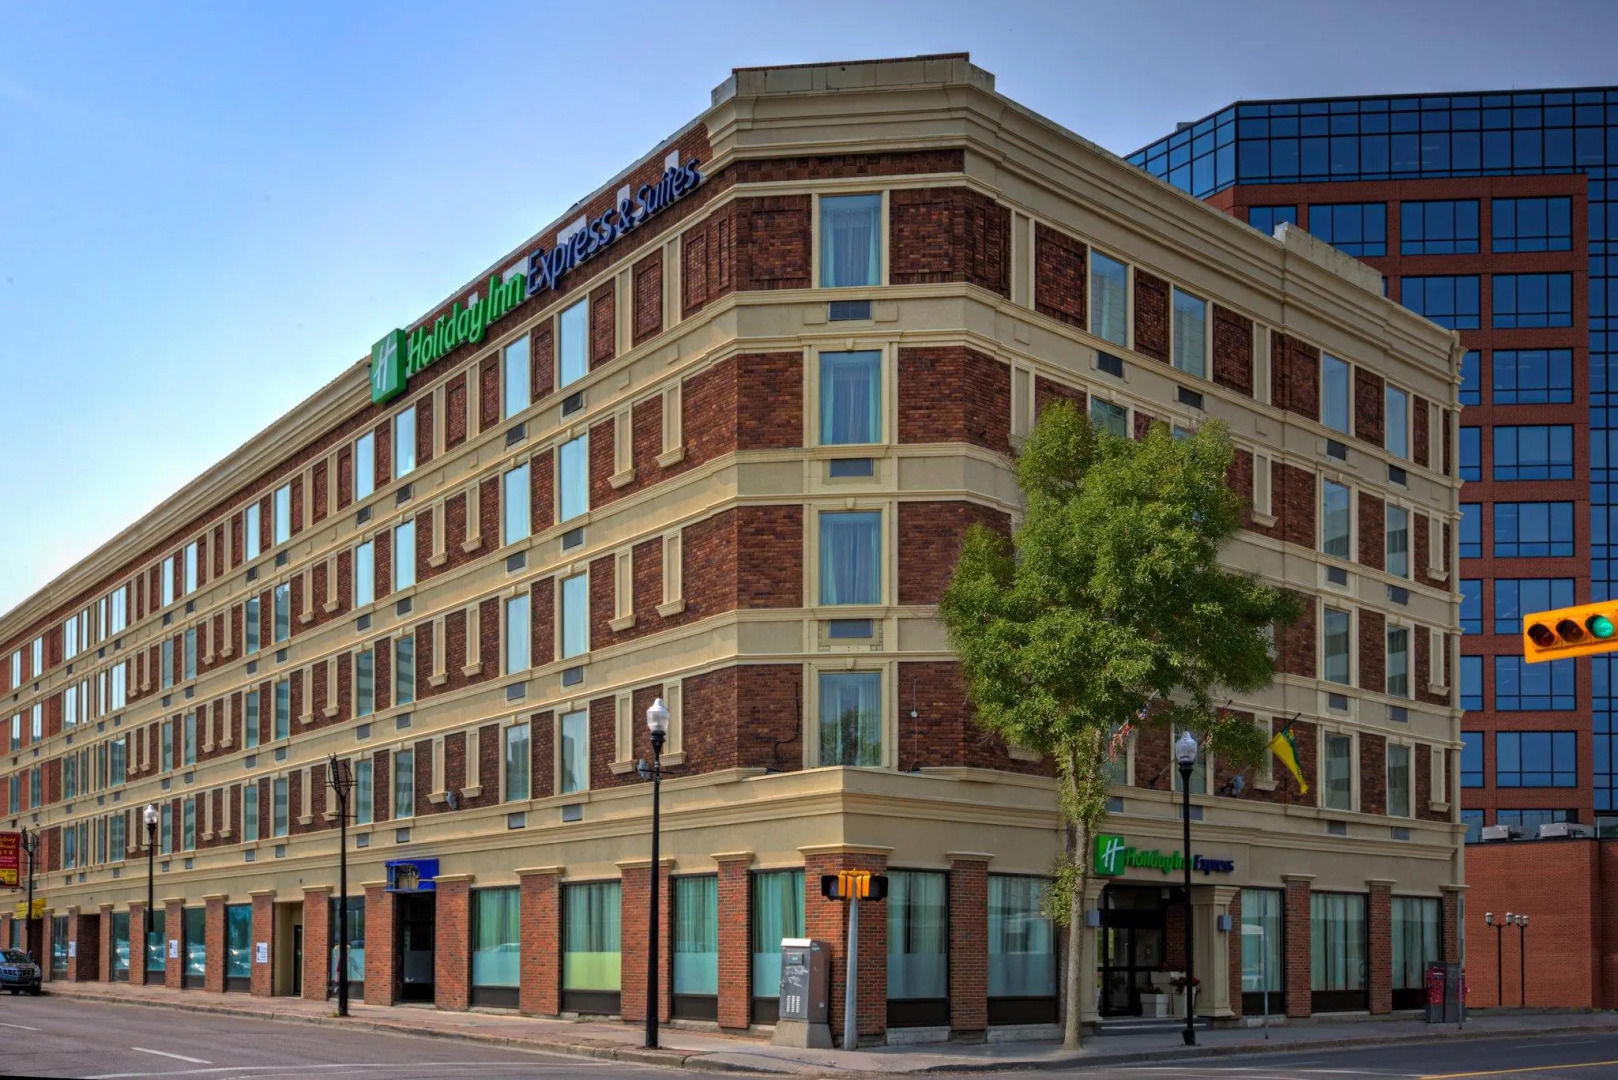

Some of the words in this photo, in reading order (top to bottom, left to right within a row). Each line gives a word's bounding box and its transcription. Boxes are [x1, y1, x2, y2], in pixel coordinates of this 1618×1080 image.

[407, 300, 487, 374] Holiday
[488, 274, 525, 322] Inn
[526, 208, 616, 290] Express
[616, 198, 633, 234] &
[635, 158, 700, 222] Suites
[1125, 847, 1173, 875] Holiday
[1194, 855, 1234, 875] Express
